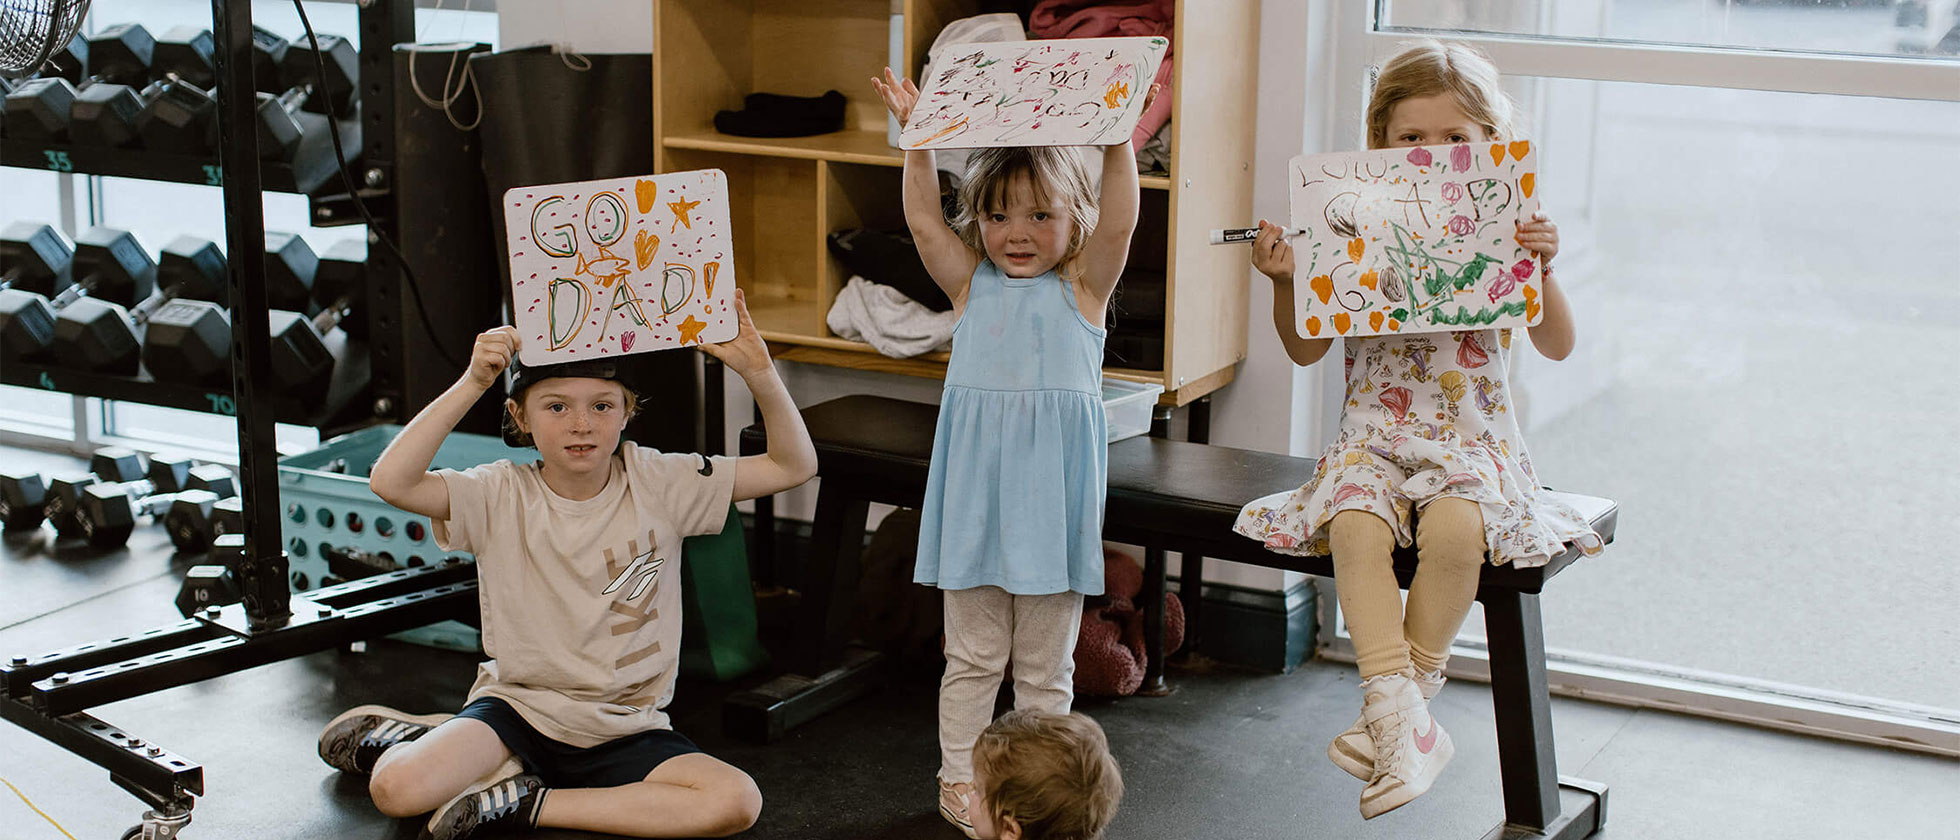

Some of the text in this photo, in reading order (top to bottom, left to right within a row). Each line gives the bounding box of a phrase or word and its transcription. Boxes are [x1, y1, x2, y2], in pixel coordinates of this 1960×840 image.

[44, 150, 73, 171] 35
[1298, 159, 1387, 188] LULU
[531, 191, 630, 258] GO
[546, 261, 720, 352] DAD!
[205, 393, 235, 415] 70
[194, 588, 209, 602] 10
[603, 529, 662, 707] IKE
